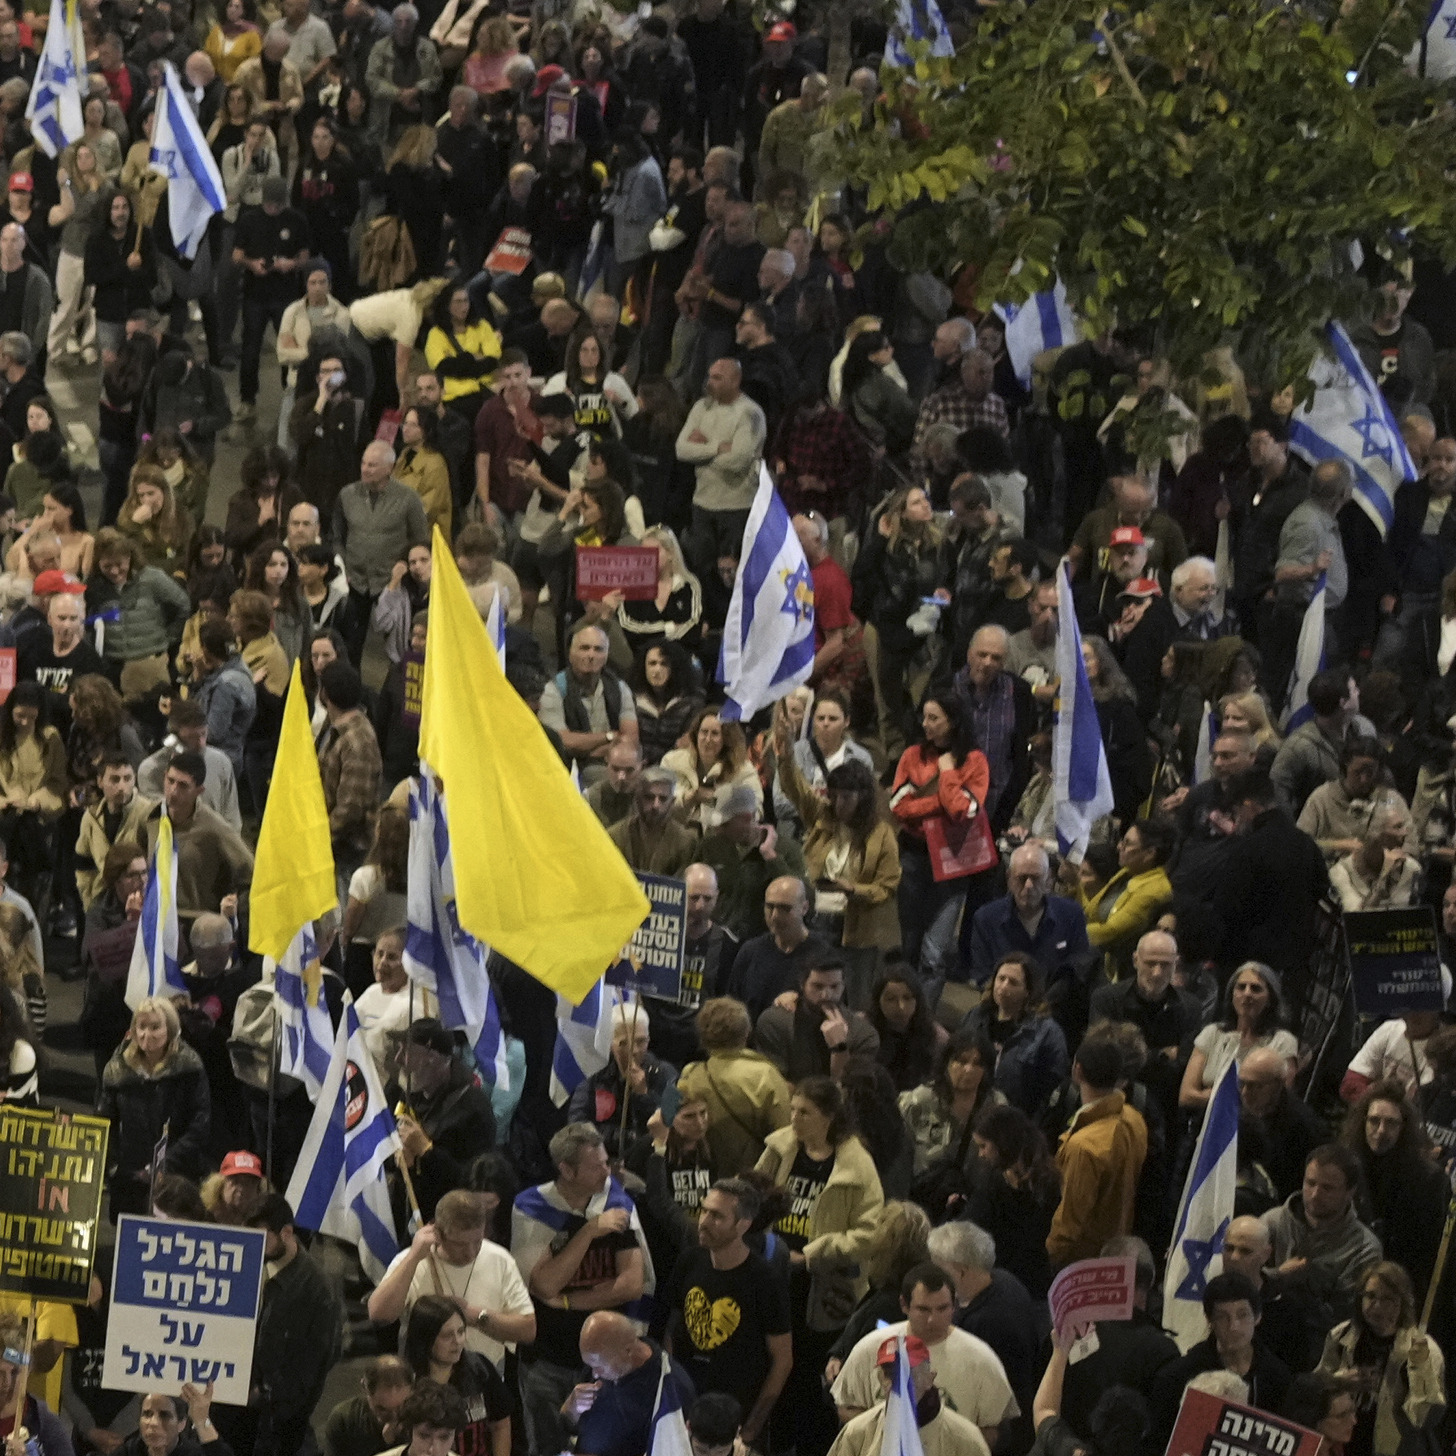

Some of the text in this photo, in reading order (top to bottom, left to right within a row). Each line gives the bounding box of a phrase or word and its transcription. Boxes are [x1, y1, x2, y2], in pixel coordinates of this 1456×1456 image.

[647, 912, 680, 934] בעד
[0, 1118, 101, 1150] הישרדות
[9, 1147, 94, 1184] נתניהו
[39, 1178, 69, 1213] או
[137, 1227, 244, 1272] הגליל
[159, 1314, 206, 1347] על
[121, 1346, 235, 1385] ישראל
[1222, 1411, 1296, 1456] מדינה
